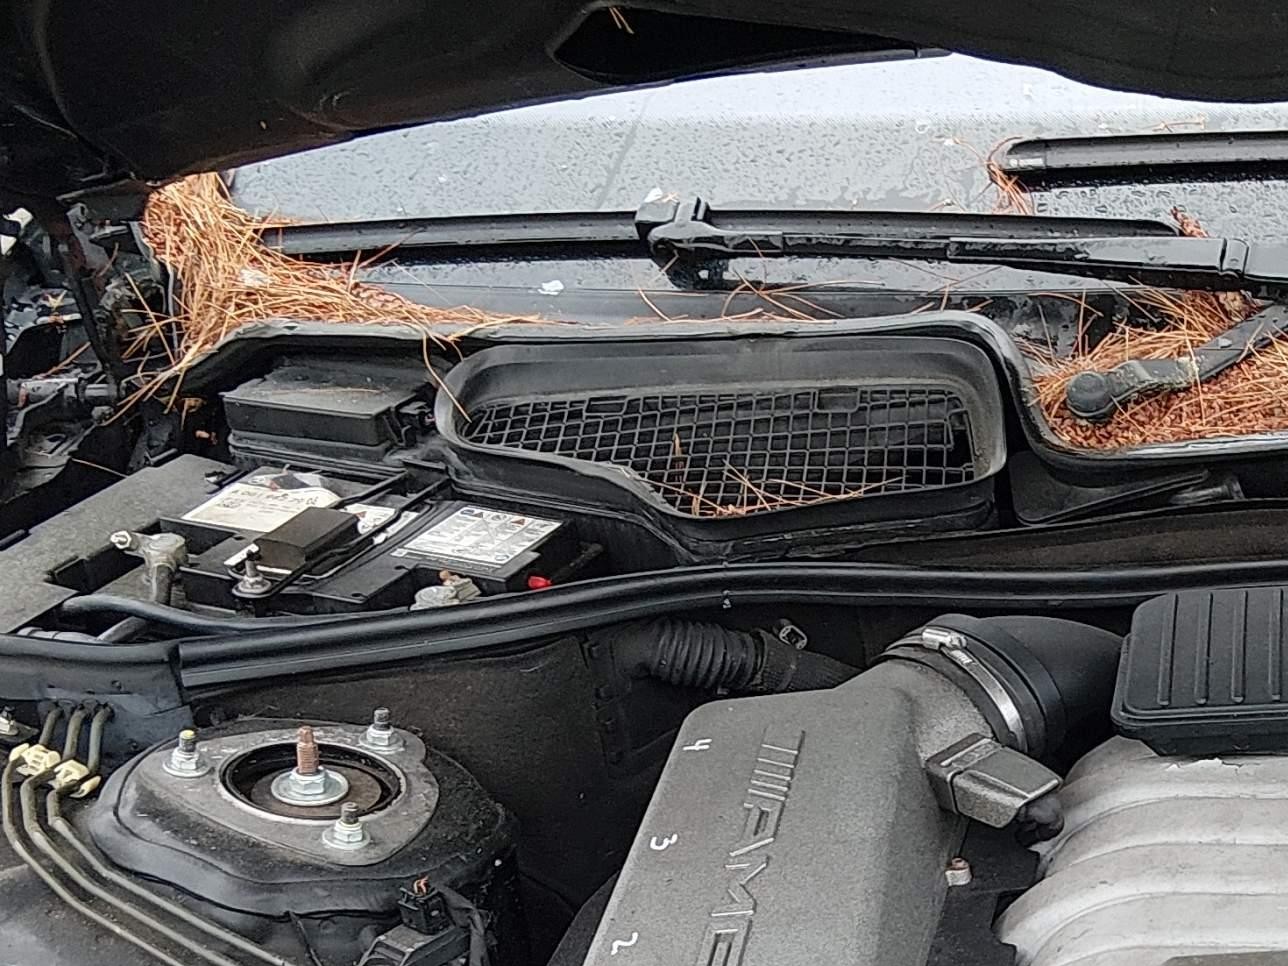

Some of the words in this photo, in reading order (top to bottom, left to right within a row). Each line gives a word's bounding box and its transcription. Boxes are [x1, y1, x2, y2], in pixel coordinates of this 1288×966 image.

[682, 738, 713, 752] 4
[650, 833, 678, 851] 3
[610, 931, 639, 956] 2
